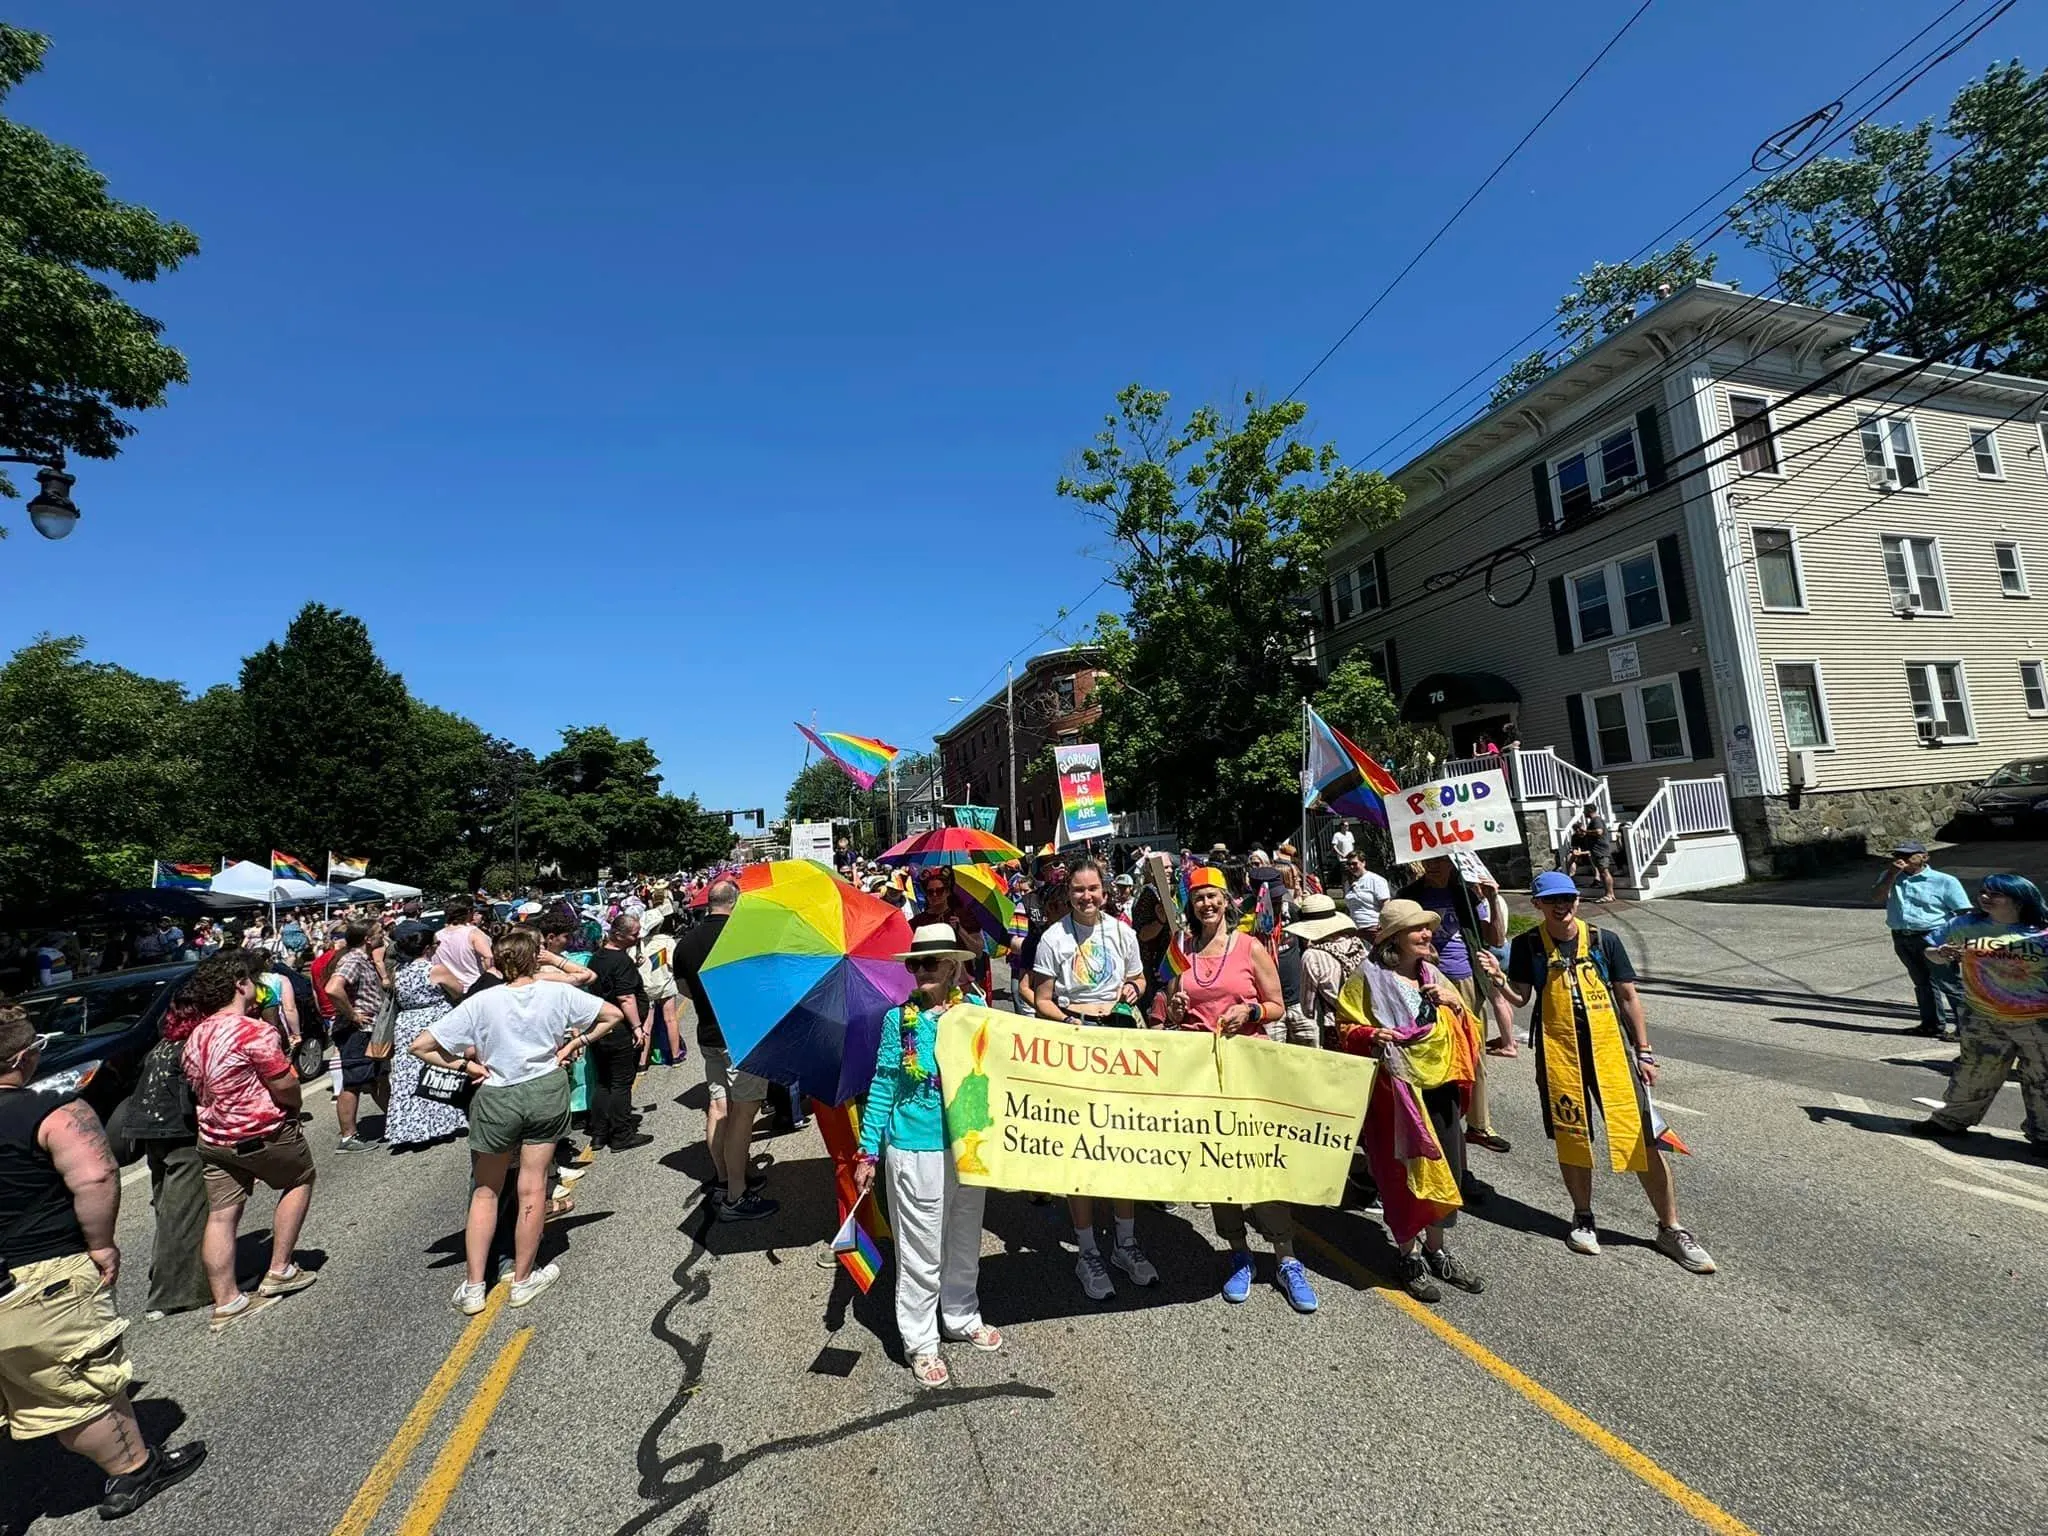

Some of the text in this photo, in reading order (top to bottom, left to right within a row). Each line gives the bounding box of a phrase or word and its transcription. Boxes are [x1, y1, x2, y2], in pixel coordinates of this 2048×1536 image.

[1429, 690, 1445, 704] 76
[1060, 753, 1097, 774] GLORIOUS
[1070, 772, 1092, 784] JUST
[1076, 784, 1089, 796] AS
[1407, 781, 1490, 815] PROUD
[1076, 795, 1095, 807] YOU
[1078, 807, 1097, 819] ARE
[1409, 819, 1474, 852] ALL
[1964, 937, 2048, 958] HIGHLY
[1976, 950, 2041, 962] CANNACO
[1586, 993, 1607, 1001] LOVE
[1010, 1033, 1162, 1077] MUUSAN
[1004, 1091, 1353, 1151] Maine Unitarian Universalist
[1003, 1124, 1289, 1173] State Advocacy Network
